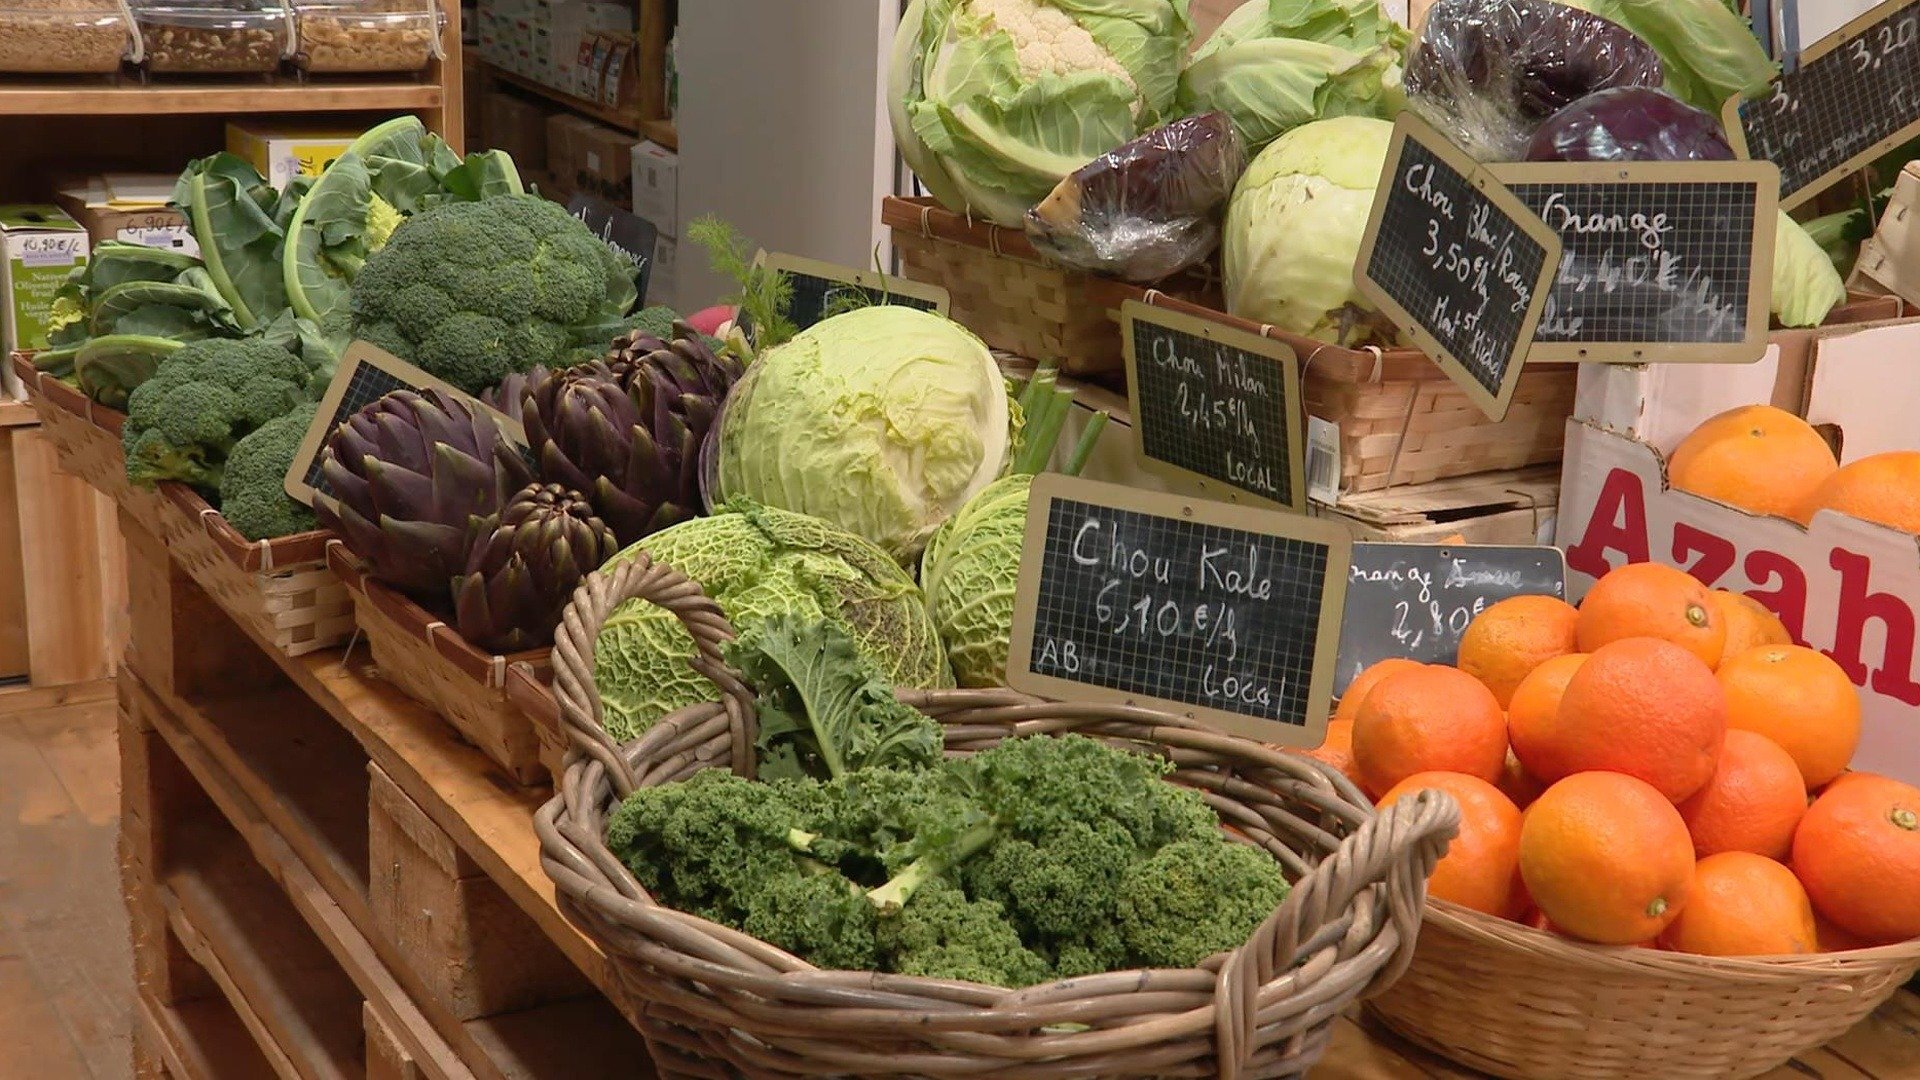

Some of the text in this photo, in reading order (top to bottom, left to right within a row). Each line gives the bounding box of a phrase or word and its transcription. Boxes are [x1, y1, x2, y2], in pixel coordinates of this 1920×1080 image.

[1405, 164, 1454, 220] Chou
[1542, 193, 1673, 249] Orange
[1153, 337, 1268, 397] Chou Milan
[1072, 517, 1271, 601] Chou Kale
[1037, 639, 1080, 673] AB
